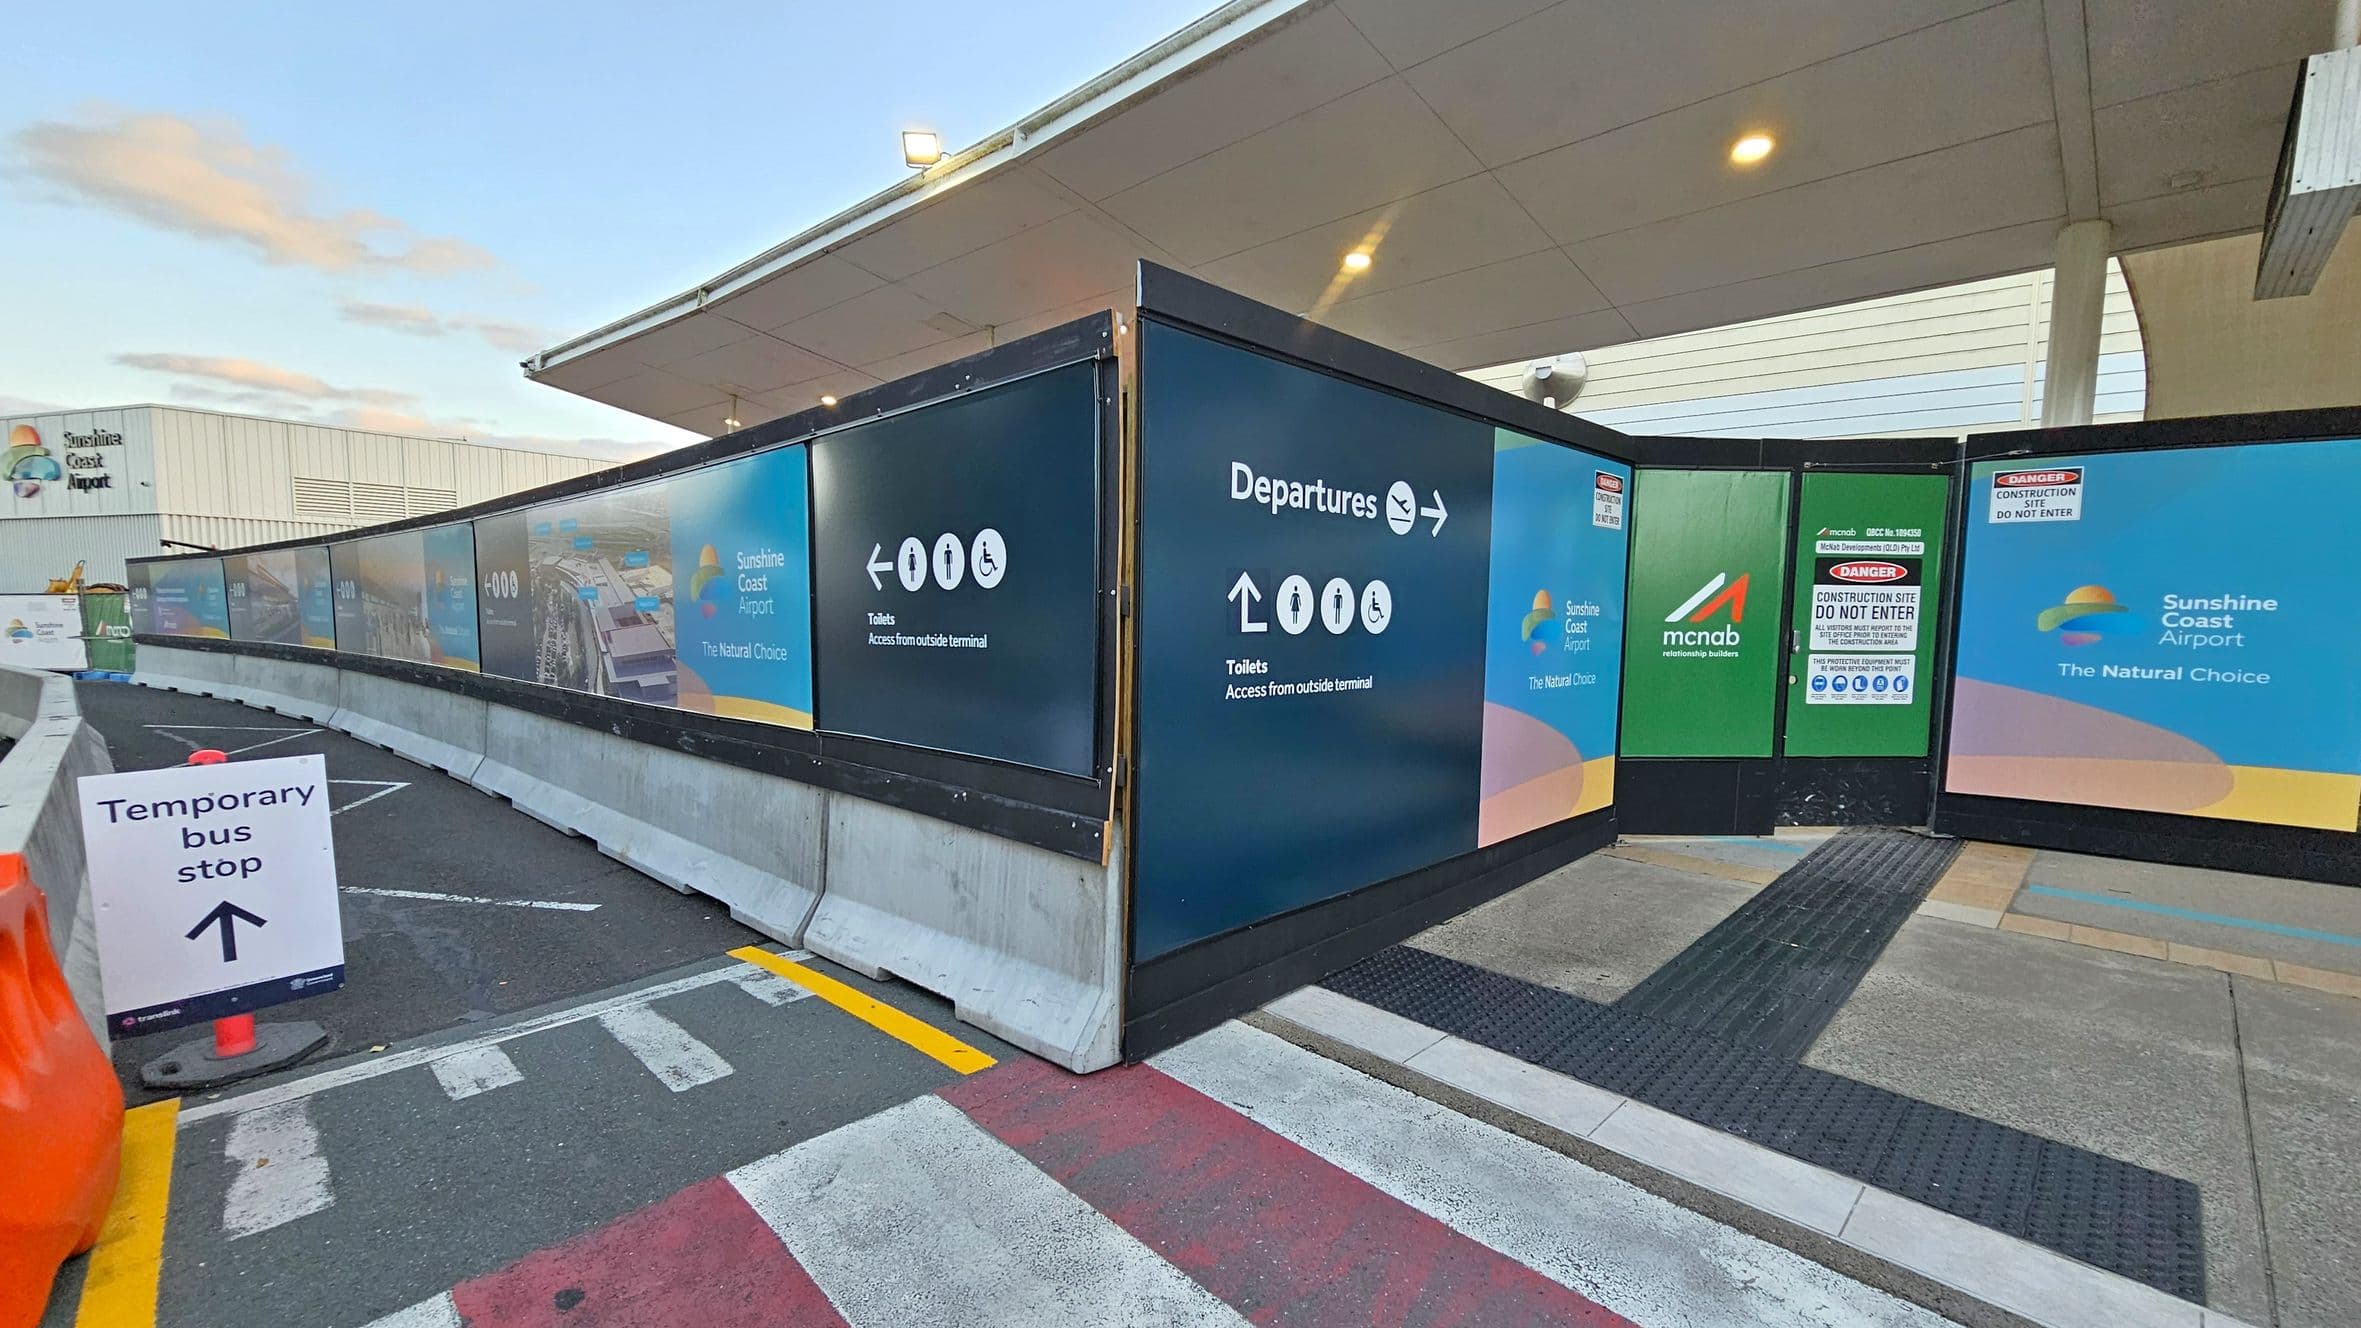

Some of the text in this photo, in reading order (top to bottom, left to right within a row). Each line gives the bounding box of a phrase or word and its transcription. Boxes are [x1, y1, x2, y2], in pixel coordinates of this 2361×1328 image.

[64, 428, 122, 448] Sunshine
[66, 452, 104, 469] Coast
[67, 473, 112, 494] Airport
[2008, 474, 2065, 484] DANGER
[1231, 461, 1377, 519] Departures
[1996, 488, 2077, 499] CONSTRUCTION
[2024, 499, 2046, 508] SITE
[1997, 508, 2073, 519] DO NOT ENTER
[1830, 528, 1856, 536] mcnab
[1820, 543, 1920, 552] McNab Developments (QLD) Pty Ltd
[737, 548, 784, 570] Sunshine
[1840, 566, 1896, 577] DANGER
[738, 574, 767, 592] Coast
[1817, 592, 1916, 603] CONSTRUCTION SITE
[2163, 594, 2278, 611] Sunshine
[738, 598, 774, 619] Airport
[1566, 600, 1599, 616] Sunshine
[1816, 605, 1915, 620] DO NOT ENTER
[868, 612, 895, 625] Toilets
[1566, 619, 1587, 633] Coast
[2161, 612, 2234, 629] Coast
[868, 633, 987, 648] Access from outside terminal
[1663, 624, 1740, 646] mcnab
[2158, 630, 2244, 650] Airport
[702, 641, 787, 661] The Natural Choice
[1564, 638, 1590, 654] Airport
[1663, 650, 1739, 659] relationship builders
[1226, 659, 1268, 675] Toilets
[2058, 663, 2271, 684] The Natural Choice
[1226, 676, 1373, 699] Access from outside terminal
[1529, 672, 1596, 690] The Natural Choice
[97, 785, 315, 823] Temporary
[182, 825, 252, 849] bus
[178, 856, 262, 882] stop
[138, 1008, 181, 1022] translink
